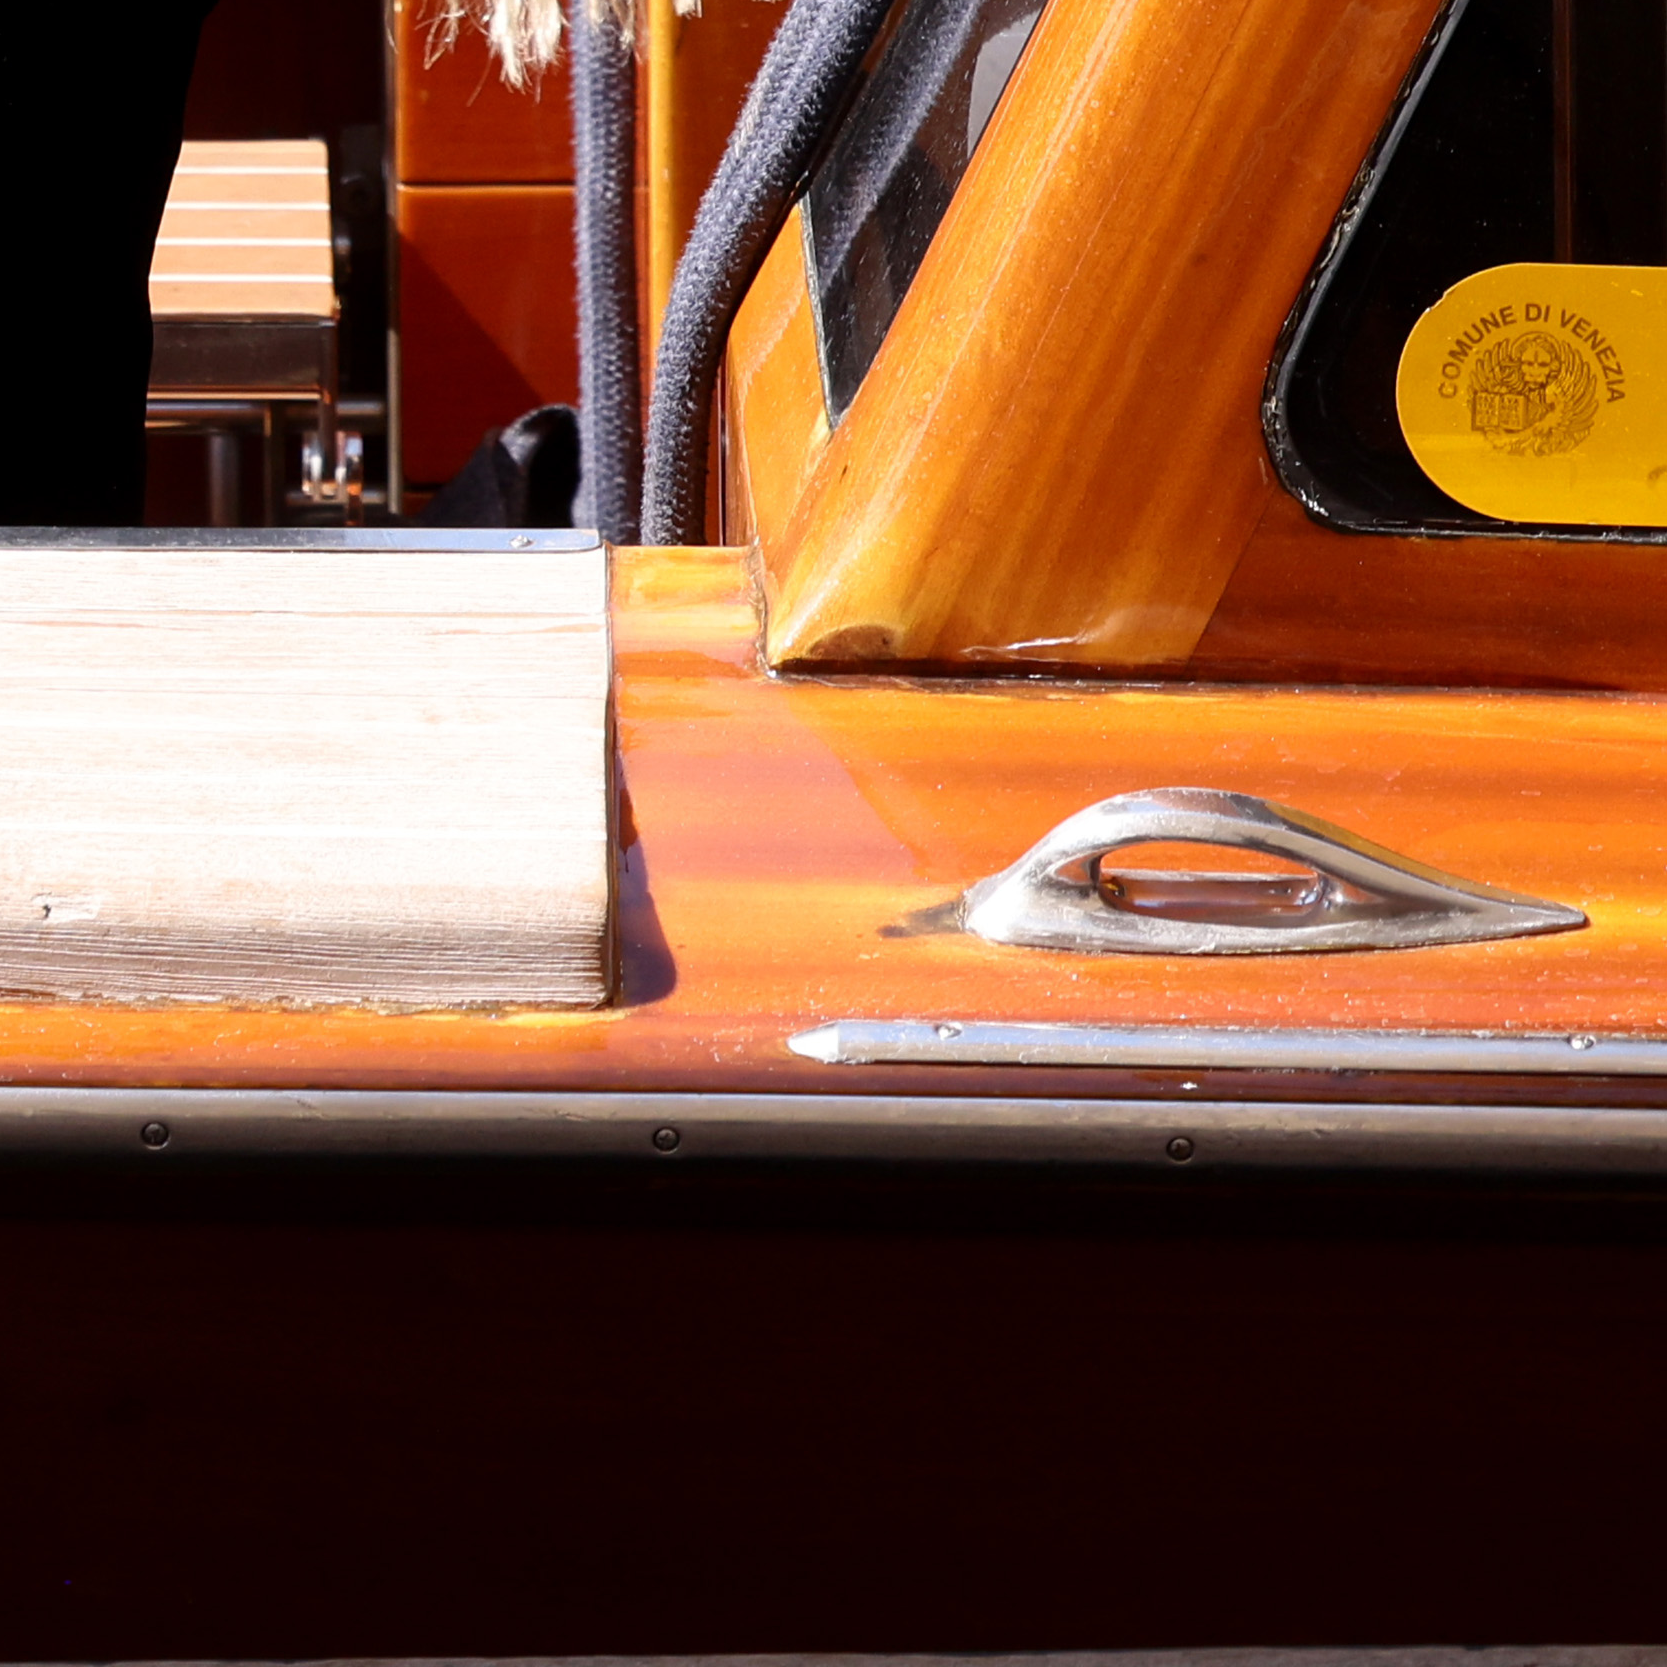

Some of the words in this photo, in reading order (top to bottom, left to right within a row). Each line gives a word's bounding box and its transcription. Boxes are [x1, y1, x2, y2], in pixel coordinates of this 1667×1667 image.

[1439, 305, 1517, 399] COMUNE
[1525, 302, 1551, 323] DI
[1560, 308, 1626, 403] VENEZIA
